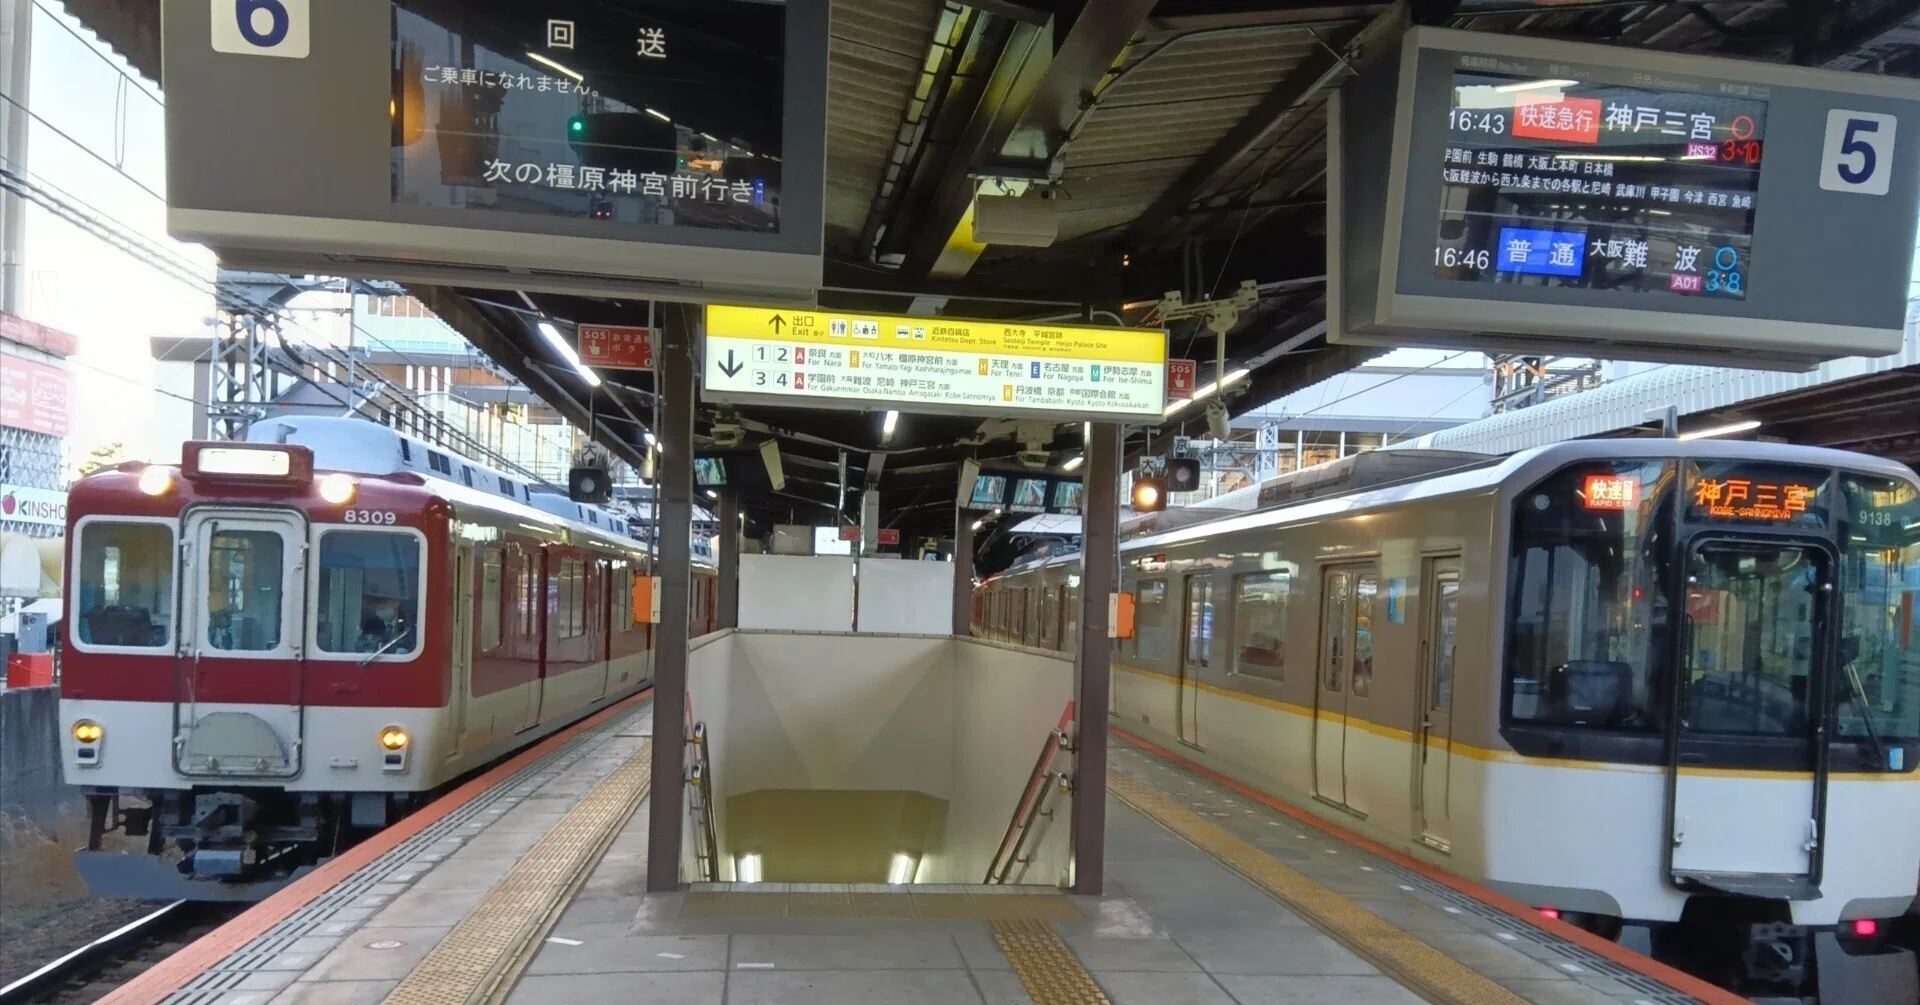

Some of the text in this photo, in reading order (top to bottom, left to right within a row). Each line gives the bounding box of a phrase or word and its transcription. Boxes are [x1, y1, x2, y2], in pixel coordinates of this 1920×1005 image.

[236, 0, 289, 47] 6
[547, 19, 667, 58] 回送
[424, 66, 599, 97] ご乗車になれません。
[1449, 109, 1505, 134] 16:43
[1520, 104, 1593, 133] 快速急行
[1605, 102, 1716, 141] 神戸三宮
[1689, 144, 1716, 159] HS32
[1838, 118, 1879, 184] 5
[1444, 148, 1615, 177] 学園前 生駒 鶴橋 大阪上本町 日本橋
[482, 159, 754, 203] 次の橿原神宮前行き
[1615, 183, 1646, 199] 武庫川
[1650, 186, 1680, 203] 甲子園
[1684, 190, 1704, 205] 今津
[1707, 192, 1728, 207] 西宮
[1732, 195, 1752, 210] 魚崎
[1434, 246, 1490, 270] 16:46
[1507, 239, 1575, 267] 普通
[1672, 275, 1699, 289] A01
[792, 315, 814, 327] 出口
[584, 330, 606, 340] SOS
[792, 327, 809, 336] Exit
[1003, 328, 1026, 337] 西大寺
[1027, 338, 1051, 347] Temple
[1056, 340, 1073, 349] Heijo
[1074, 340, 1094, 348] Palace
[757, 346, 788, 361] 1 2
[796, 352, 804, 360] A
[808, 348, 827, 358] 奈良
[992, 359, 1009, 369] 天理
[1044, 362, 1070, 373] 名古屋
[1103, 365, 1138, 376] 伊勢志摩
[1170, 365, 1190, 374] SOS
[756, 371, 788, 387] 3 4
[795, 376, 803, 384] A
[1006, 370, 1023, 378] Tenri
[1058, 374, 1084, 383] Nagoya
[1119, 376, 1153, 385] Ise-Shima
[807, 373, 836, 384] 学園前
[876, 376, 895, 387] 尼崎
[899, 378, 936, 390] 神戸三宮
[820, 384, 860, 393] Gakuemmae
[909, 389, 942, 399] Amagasaki
[1015, 385, 1042, 396] 丹波橋
[1047, 387, 1065, 397] 京都
[1067, 397, 1085, 406] Kyoto
[583, 443, 597, 456] 大
[1175, 438, 1188, 450] 京
[1142, 459, 1155, 471] 大
[1696, 477, 1808, 512] 神戸三宮
[19, 499, 67, 520] KINSHO
[1590, 499, 1613, 507] RAPID
[344, 509, 397, 525] 8309
[1859, 510, 1891, 526] 9138
